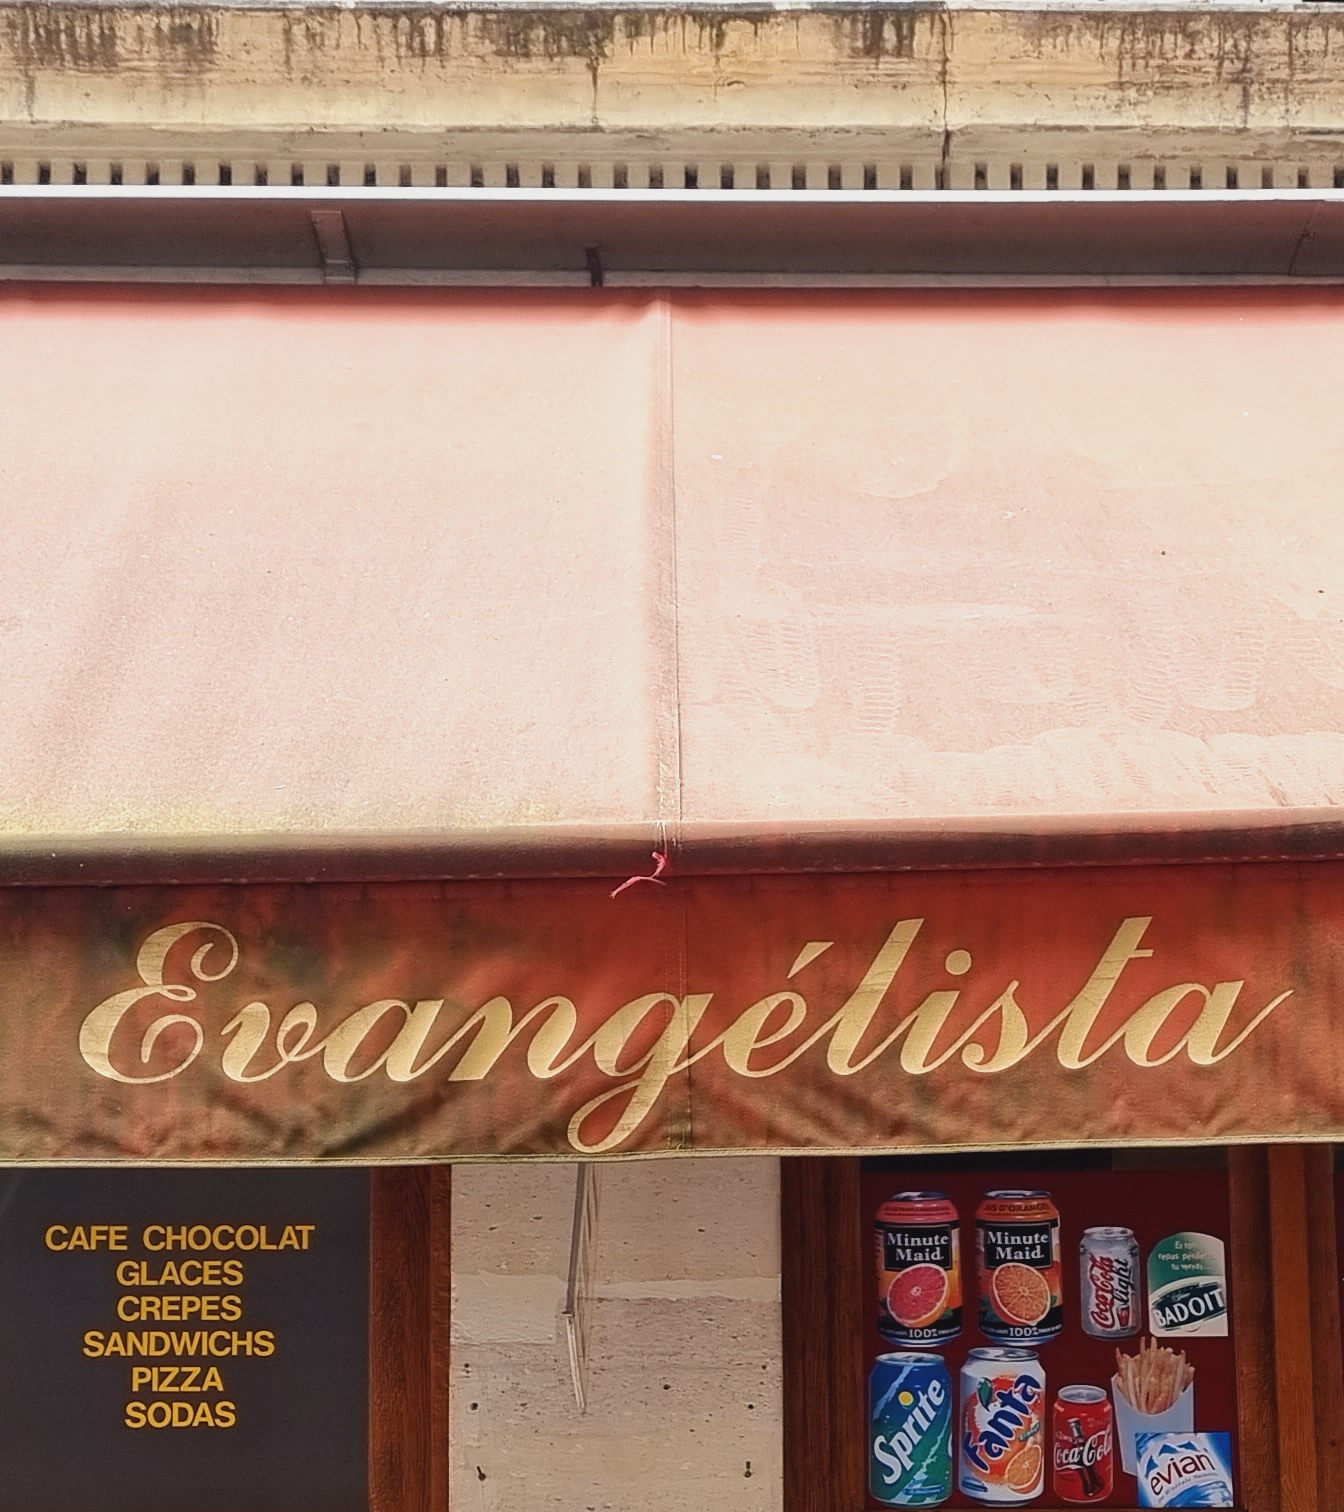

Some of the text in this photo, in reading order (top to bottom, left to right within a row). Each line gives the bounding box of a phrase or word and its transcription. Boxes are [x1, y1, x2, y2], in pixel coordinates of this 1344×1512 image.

[78, 916, 1294, 1154] Evangélista
[45, 1225, 315, 1250] CAFE CHOCOLAT
[887, 1232, 949, 1247] Minute
[988, 1231, 1049, 1245] Minute
[896, 1248, 943, 1261] Maid
[996, 1246, 1044, 1260] Maid
[116, 1260, 244, 1286] GLACES
[117, 1295, 242, 1321] CREPES
[1155, 1288, 1225, 1327] BADOIT
[83, 1330, 275, 1357] SANDWICHS
[132, 1367, 224, 1392] PIZZA
[125, 1402, 236, 1428] SODAS
[964, 1374, 1041, 1474] Fanta
[874, 1379, 945, 1485] Sprite
[1150, 1453, 1216, 1496] evian
